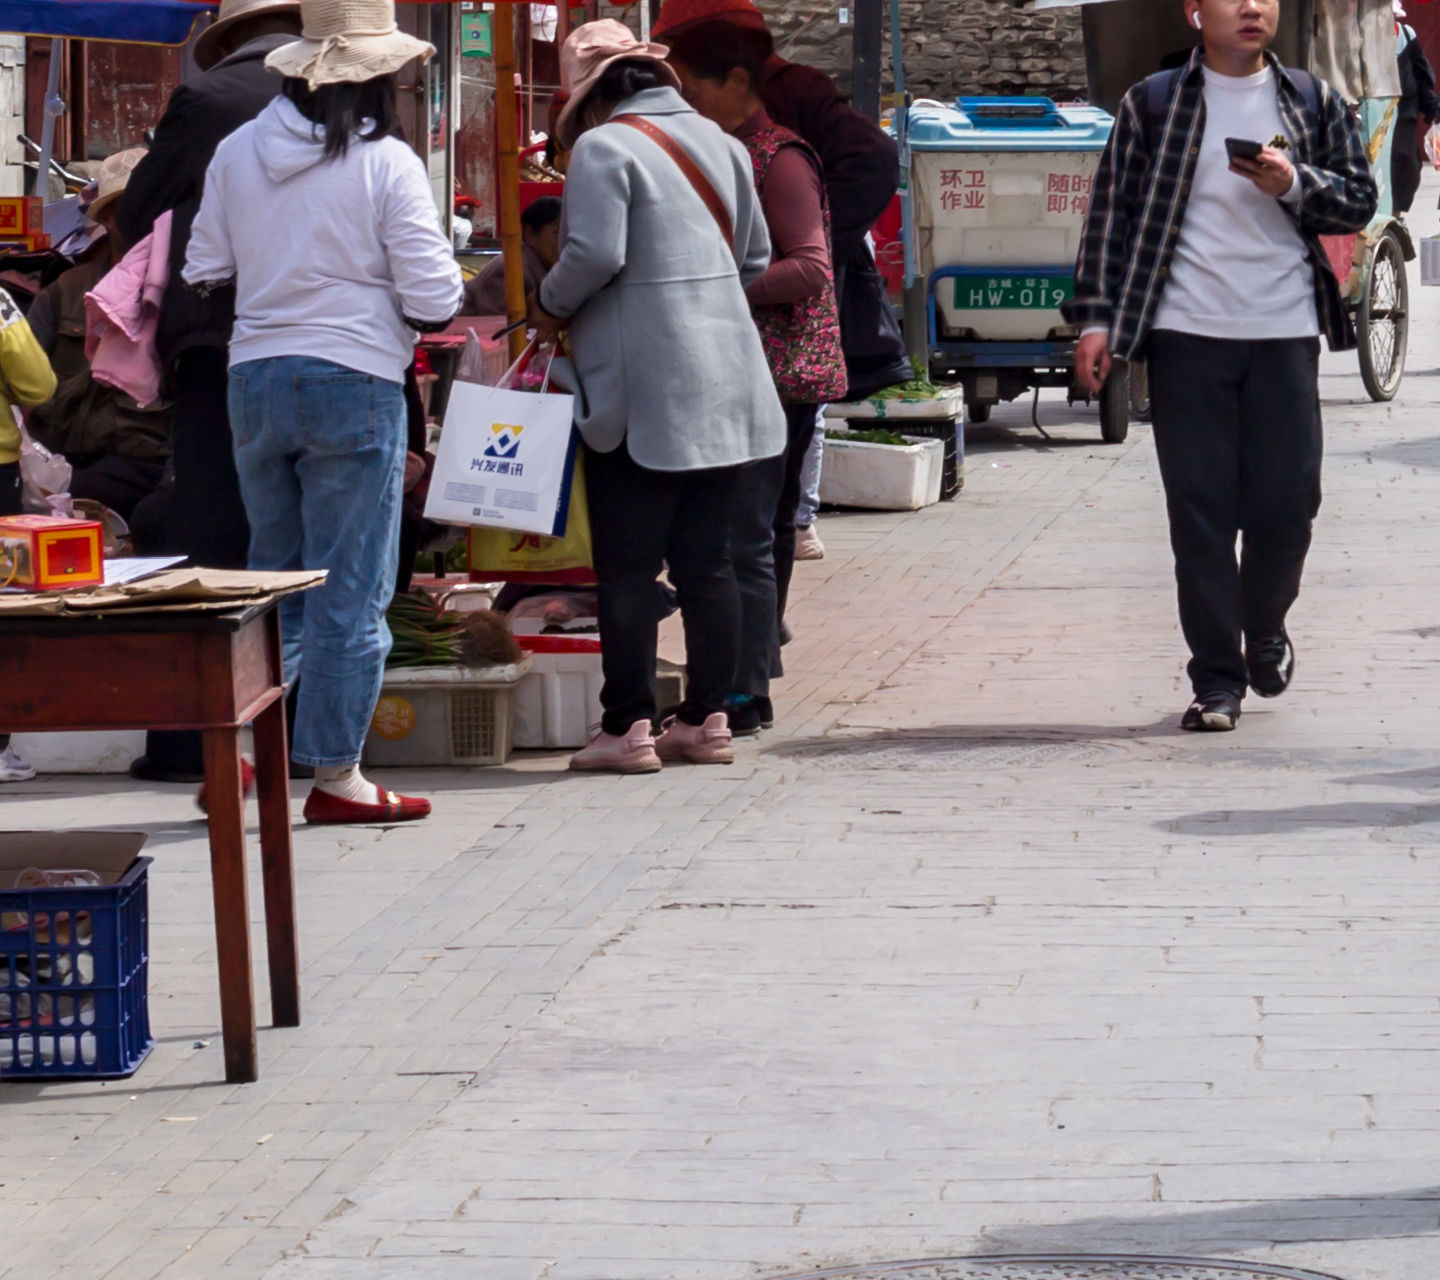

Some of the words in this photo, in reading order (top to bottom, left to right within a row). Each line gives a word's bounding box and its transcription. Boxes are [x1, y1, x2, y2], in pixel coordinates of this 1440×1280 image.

[940, 169, 986, 189] 环卫
[1047, 173, 1093, 194] 随时
[940, 190, 985, 210] 作业
[470, 458, 524, 477] 兴发通讯
